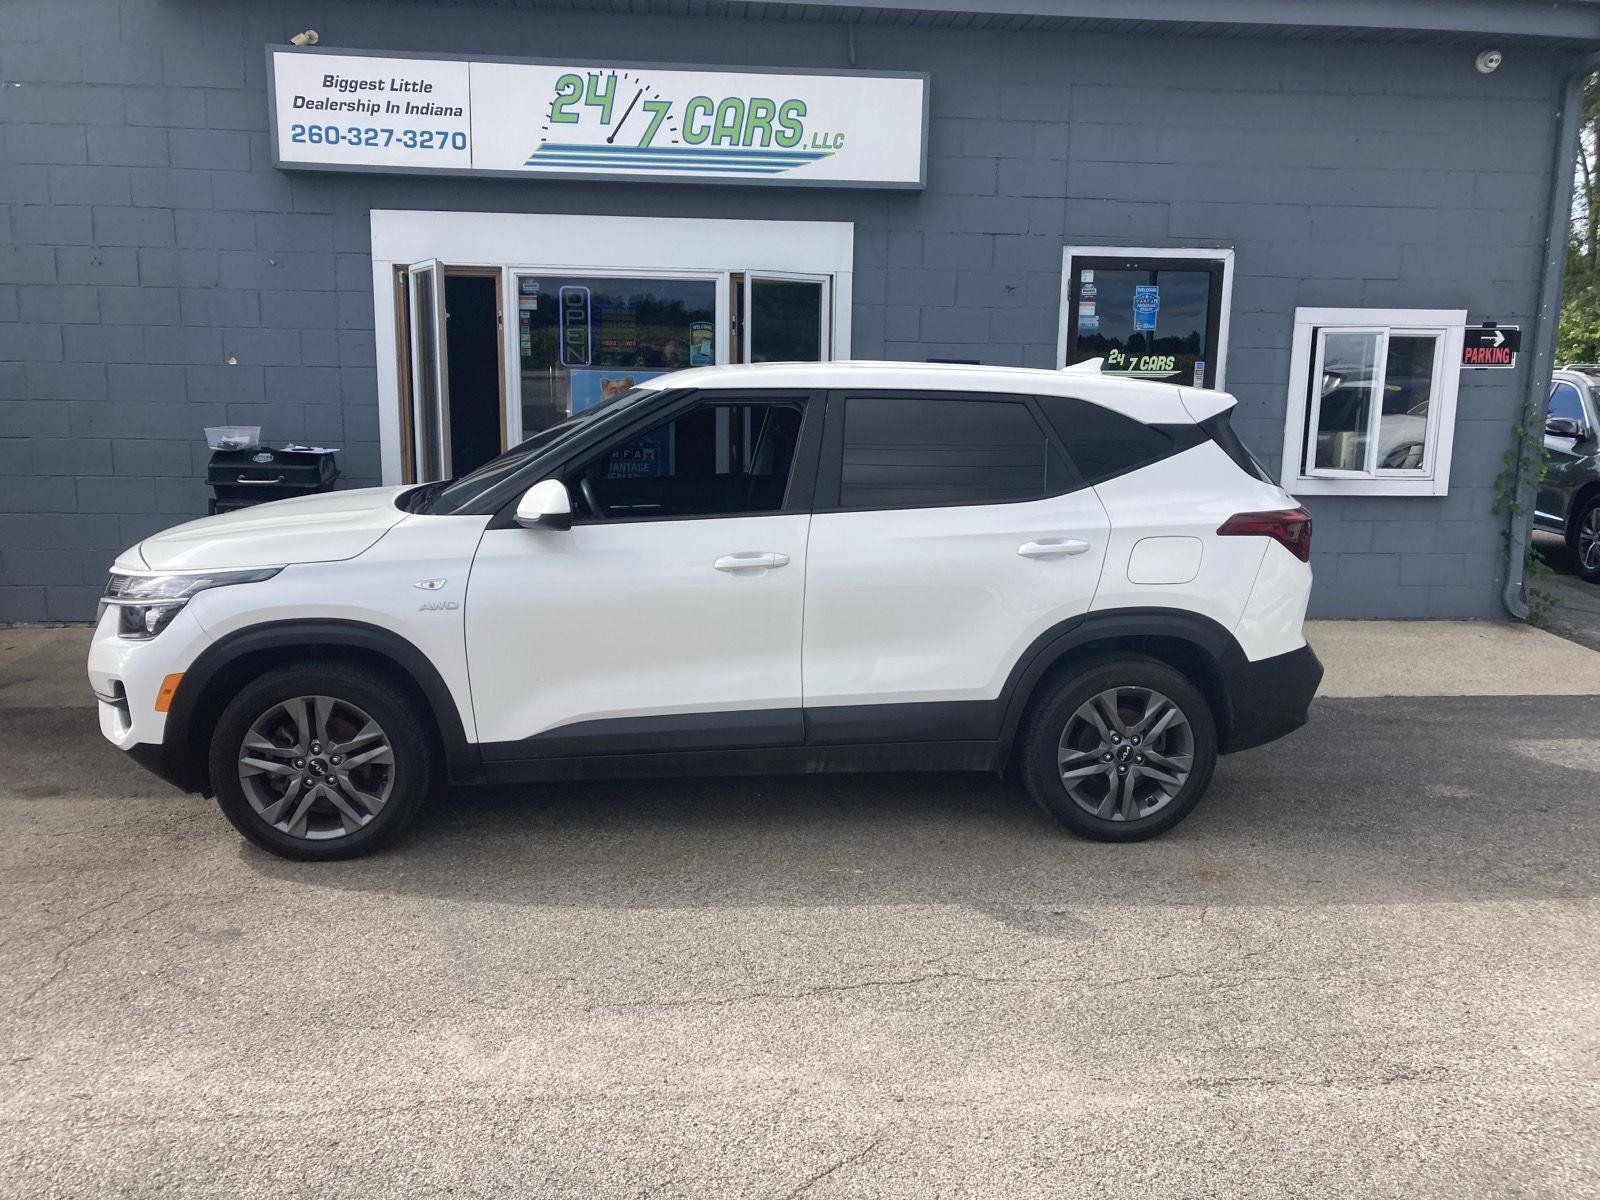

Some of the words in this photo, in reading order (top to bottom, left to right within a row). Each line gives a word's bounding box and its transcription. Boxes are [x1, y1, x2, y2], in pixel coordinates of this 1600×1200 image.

[322, 74, 386, 93] Biggest
[390, 78, 433, 94] Little
[292, 95, 381, 116] Dealership
[385, 101, 400, 114] In
[405, 102, 463, 117] Indiana
[291, 124, 467, 150] 260-327-3270
[811, 131, 845, 150] LLC
[566, 292, 585, 362] OPEN
[1108, 349, 1125, 365] 24
[1140, 356, 1175, 371] CARS
[1465, 347, 1510, 364] PARKING
[419, 601, 459, 611] AWD
